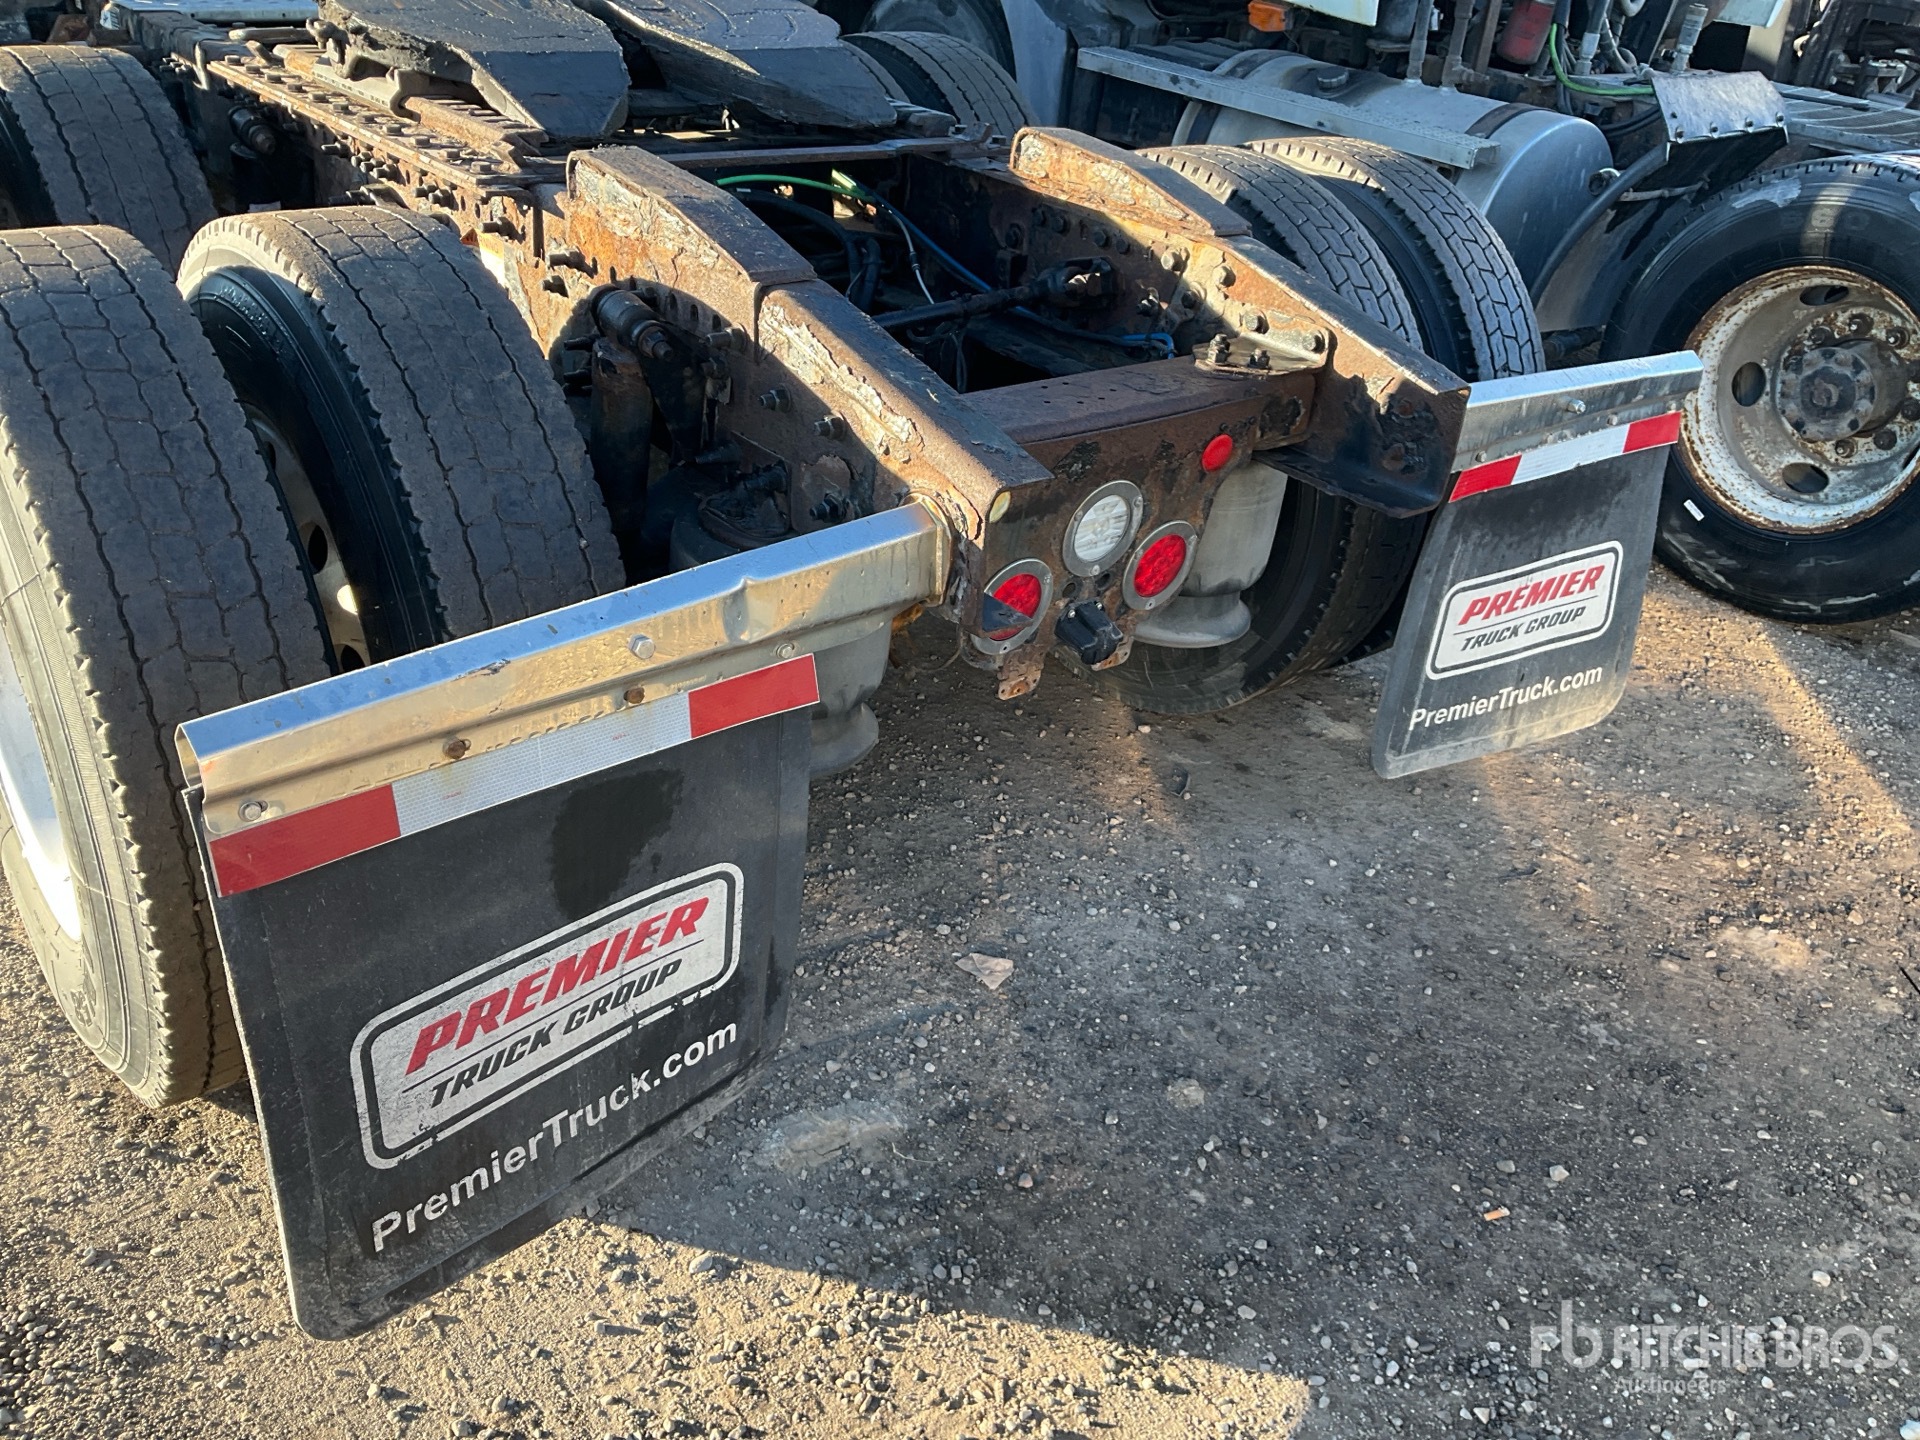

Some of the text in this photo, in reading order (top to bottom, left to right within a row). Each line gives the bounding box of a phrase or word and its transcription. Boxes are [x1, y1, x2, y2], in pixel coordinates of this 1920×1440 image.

[1458, 564, 1605, 626] PREMIER
[1461, 605, 1587, 652] TRUCK GROUP
[1408, 666, 1603, 731] PremierTruck.com
[405, 897, 709, 1076] PREMIER
[430, 958, 683, 1109] TRUCK GROUP
[371, 1022, 737, 1253] PremierTruck.com
